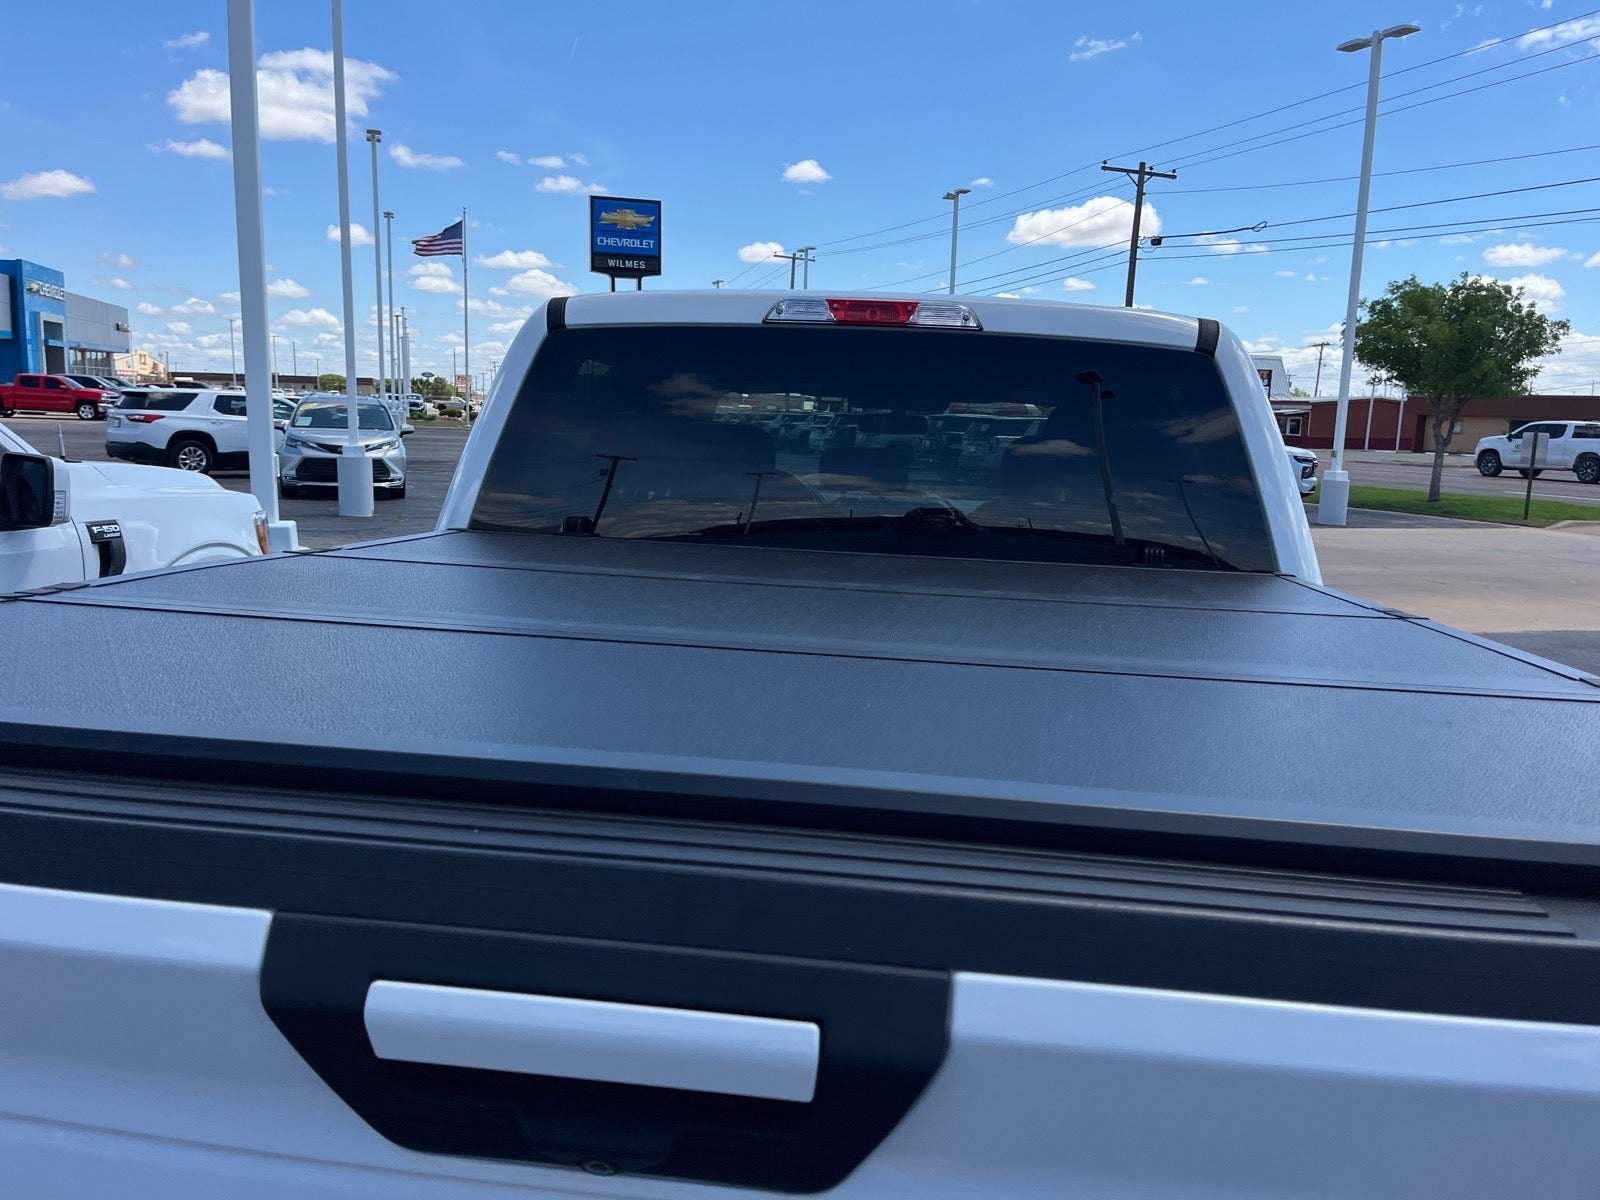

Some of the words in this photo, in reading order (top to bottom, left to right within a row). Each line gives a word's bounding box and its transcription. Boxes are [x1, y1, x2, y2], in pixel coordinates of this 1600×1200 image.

[597, 236, 655, 249] CHEVROLET
[607, 258, 646, 269] WILMES
[91, 524, 120, 534] F-150
